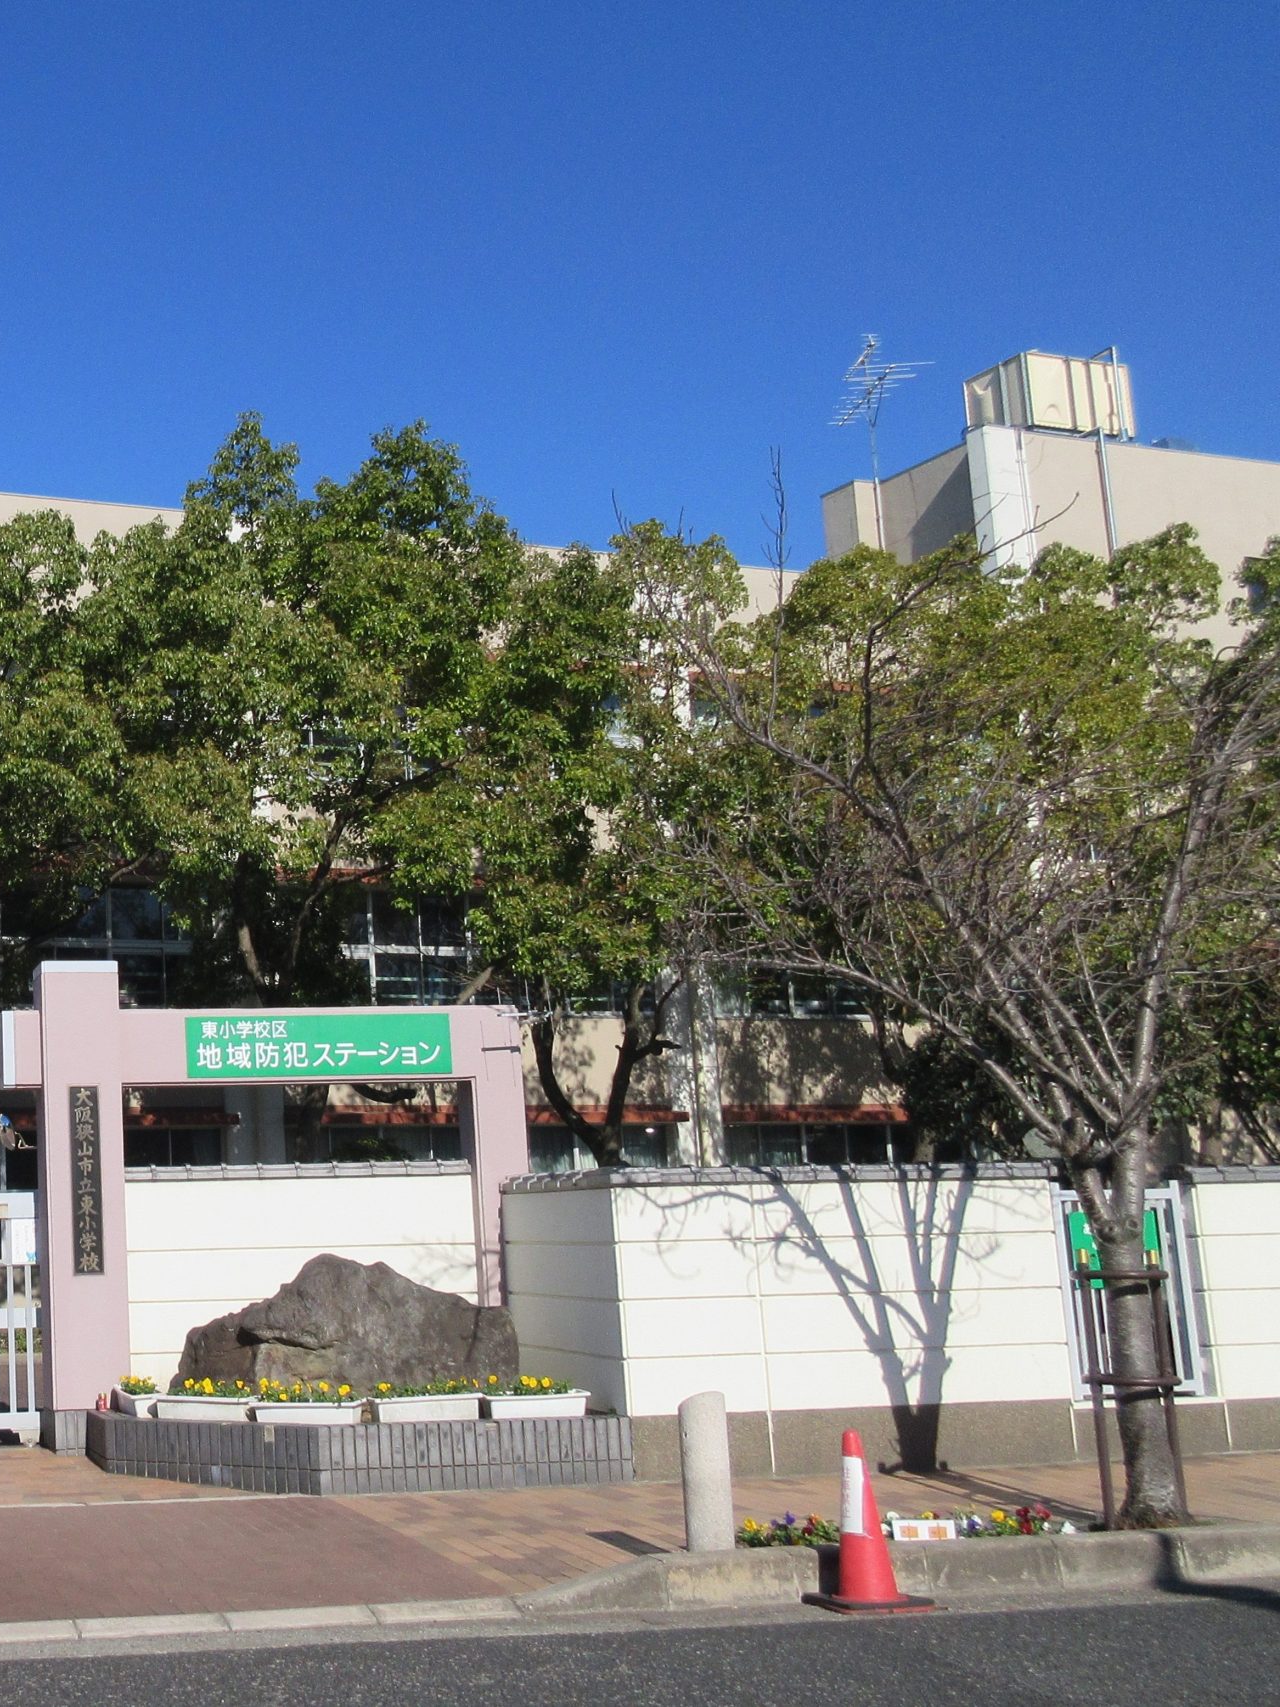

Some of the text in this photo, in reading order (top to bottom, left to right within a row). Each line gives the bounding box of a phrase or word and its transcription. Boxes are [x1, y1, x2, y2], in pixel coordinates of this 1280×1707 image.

[201, 1021, 287, 1039] 東小学校区
[197, 1041, 440, 1069] 地域防犯ステーション
